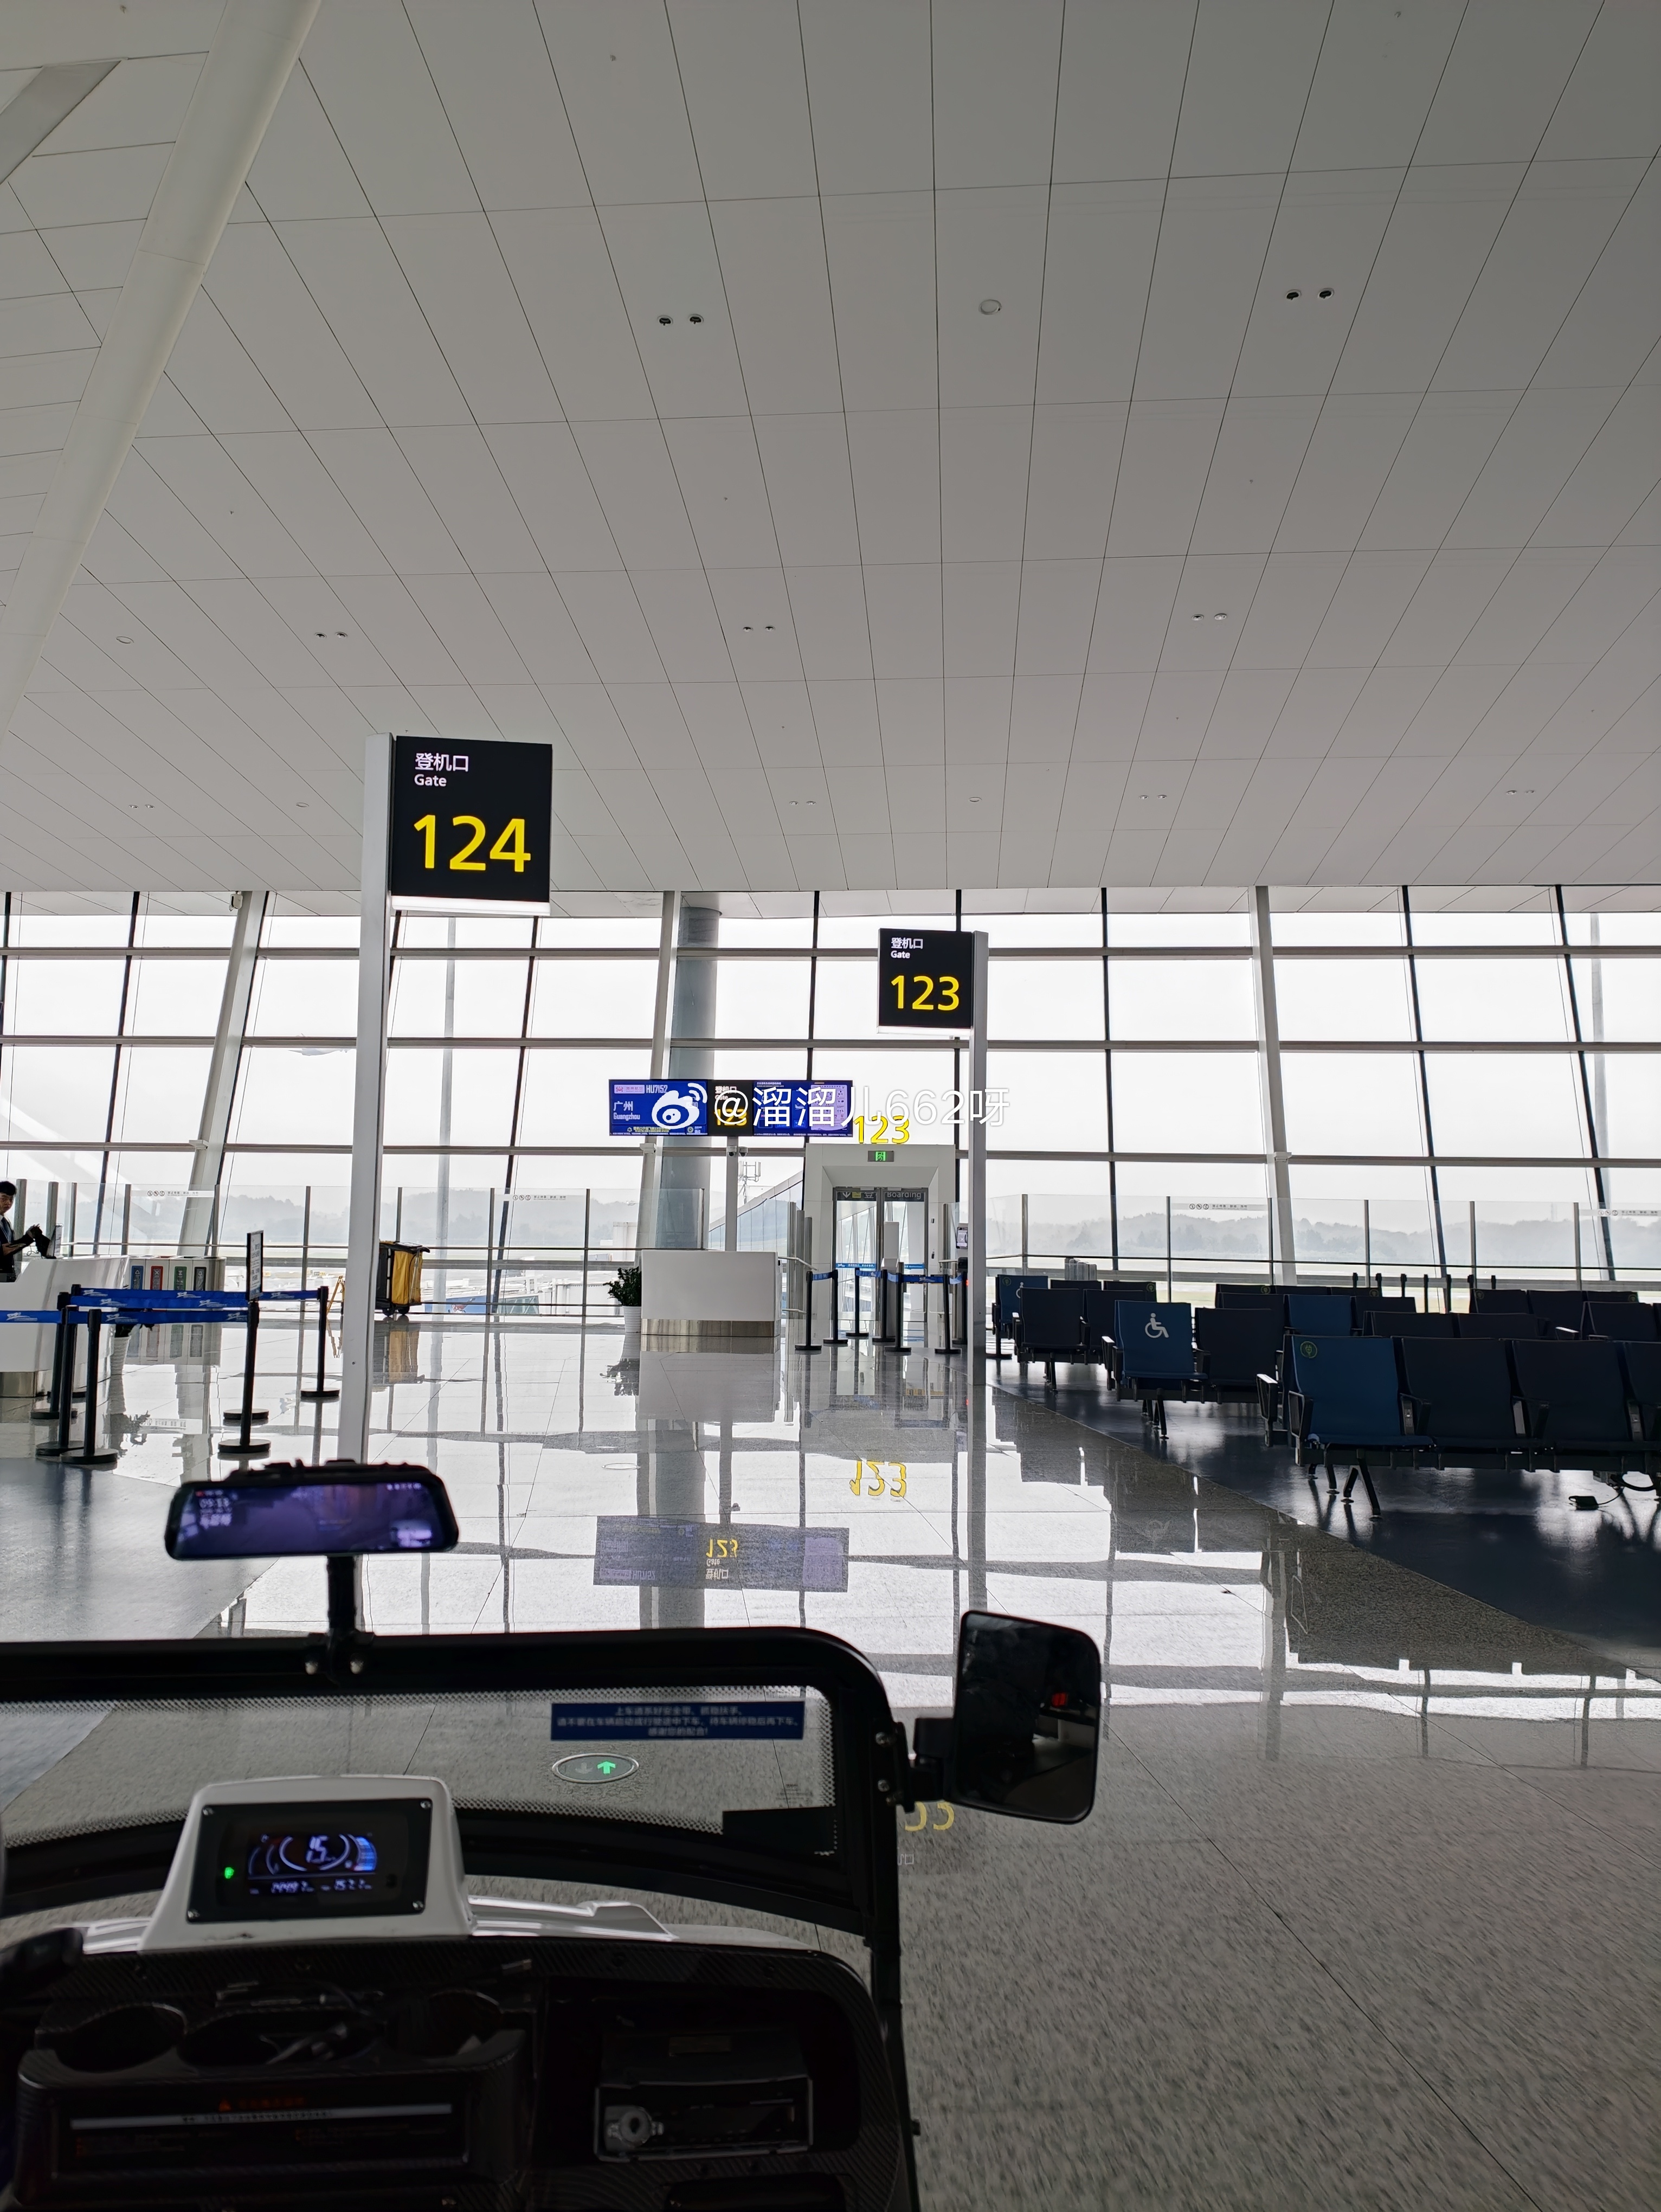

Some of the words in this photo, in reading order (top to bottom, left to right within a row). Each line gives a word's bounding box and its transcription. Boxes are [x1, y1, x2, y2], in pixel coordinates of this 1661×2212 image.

[415, 753, 469, 771] 登机口
[414, 774, 447, 787] Gate
[414, 815, 531, 872] 124
[891, 937, 923, 949] 登机口
[891, 950, 910, 959] Gate
[891, 975, 959, 1011] 123
[646, 1084, 668, 1094] HU7152
[613, 1101, 633, 1111] 广州
[613, 1113, 640, 1121] Guangzhou
[853, 1115, 910, 1144] 123
[887, 1192, 922, 1200] Boarding
